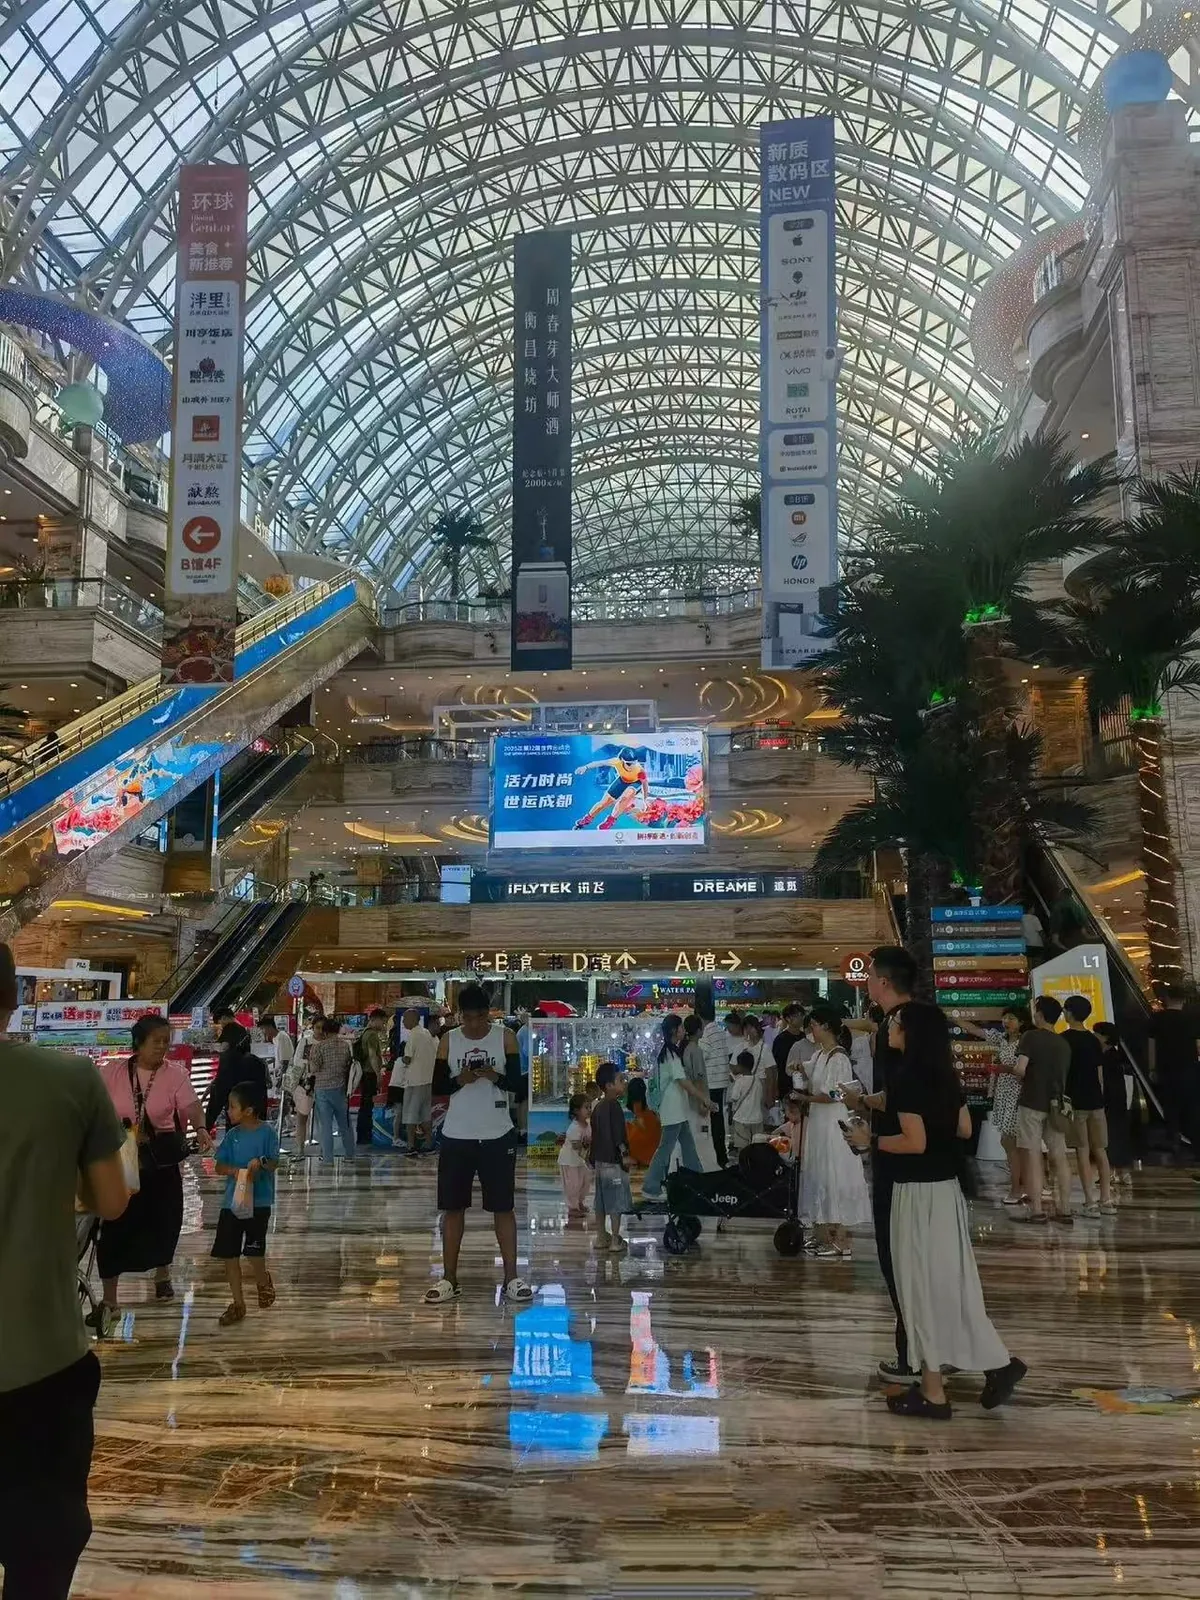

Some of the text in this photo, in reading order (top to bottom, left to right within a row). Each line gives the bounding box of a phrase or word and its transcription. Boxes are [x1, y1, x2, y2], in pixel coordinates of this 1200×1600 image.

[767, 140, 809, 162] 新质
[767, 159, 830, 184] 数码区
[769, 185, 811, 201] NEW
[191, 192, 235, 212] 环球
[189, 241, 219, 256] 美食
[188, 257, 233, 271] 新推荐
[781, 256, 813, 266] SONY
[785, 367, 811, 376] vivo
[180, 557, 222, 571] B馆4F
[783, 577, 816, 585] HONOR
[503, 773, 573, 788] 活力时尚
[503, 794, 573, 809] 世运成都
[508, 881, 605, 895] iFLYTEK 讯飞
[693, 881, 757, 893] DREAME
[674, 951, 716, 972] A馆
[1083, 956, 1100, 968] L1
[711, 1193, 738, 1206] Jeep
